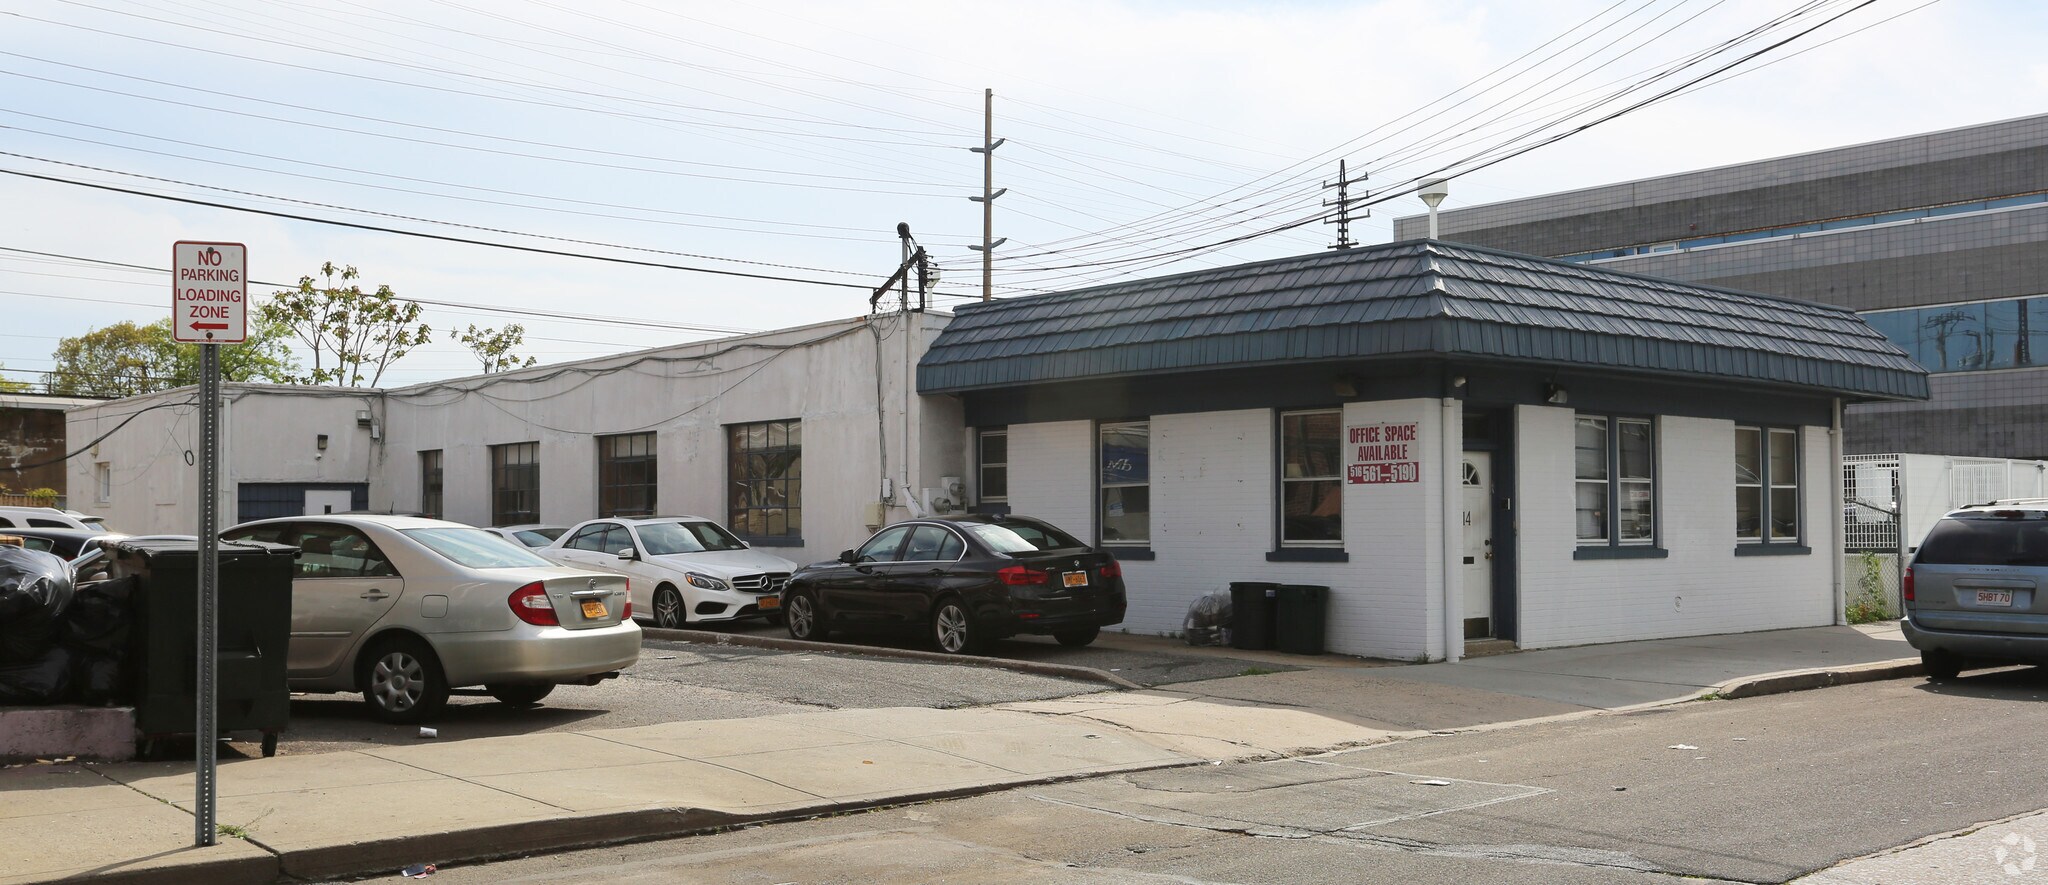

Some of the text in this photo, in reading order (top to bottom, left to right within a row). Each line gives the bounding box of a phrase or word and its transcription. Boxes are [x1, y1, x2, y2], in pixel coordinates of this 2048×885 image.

[198, 250, 222, 267] NO
[181, 268, 239, 282] PARKING
[178, 288, 241, 303] LOADING
[190, 305, 229, 318] ZONE
[1350, 425, 1416, 444] OFFICE SPACE
[1358, 444, 1408, 461] AVAILABLE
[1350, 466, 1362, 477] 516
[1978, 592, 2010, 602] 5HBT 70
